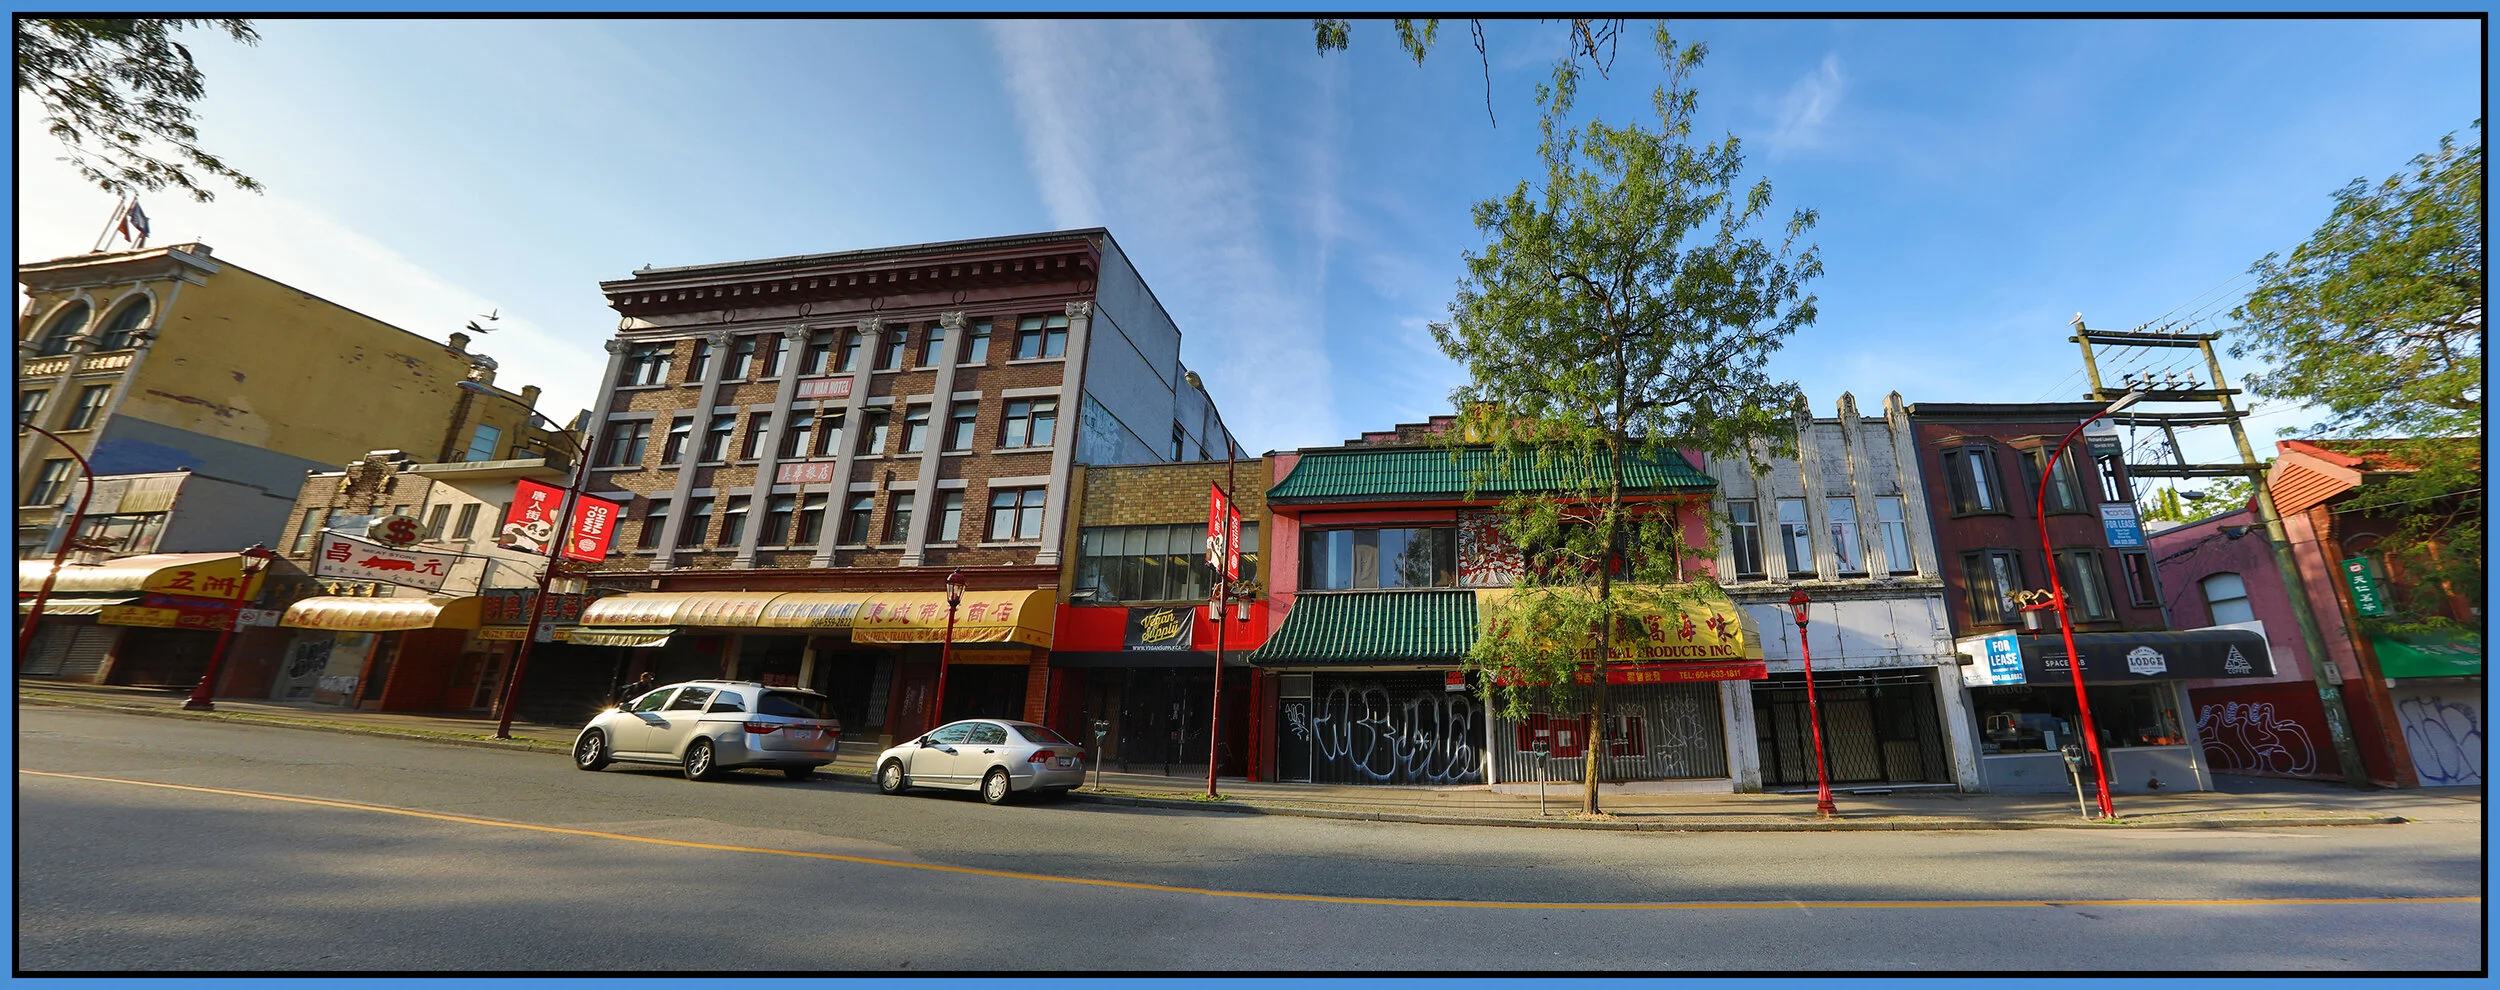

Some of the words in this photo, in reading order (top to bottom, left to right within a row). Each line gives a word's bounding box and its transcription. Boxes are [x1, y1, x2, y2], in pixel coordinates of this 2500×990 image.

[800, 381, 813, 395] MAY
[828, 380, 849, 394] HOTEL
[525, 490, 547, 521] 唐人街
[582, 505, 598, 533] TOWN
[590, 507, 608, 535] CHINA
[2105, 520, 2118, 529] FOR
[2118, 519, 2137, 529] LEASE
[326, 542, 352, 562] 昌
[416, 559, 444, 577] 元
[362, 548, 387, 556] MEAT
[388, 551, 417, 561] STORE
[767, 603, 796, 618] CARE
[795, 603, 825, 618] HOME
[824, 603, 857, 618] MART
[1141, 609, 1175, 628] Vegan
[890, 631, 914, 641] TRADING
[1142, 622, 1180, 642] Supply
[1580, 647, 1633, 660] HEBAL
[1711, 645, 1736, 656] INC.
[1992, 639, 2011, 652] FOR
[1990, 653, 2018, 666] LEASE
[2129, 657, 2164, 666] LODGE
[1679, 671, 1694, 679] TEL:
[1695, 670, 1740, 679] 604-633-1811
